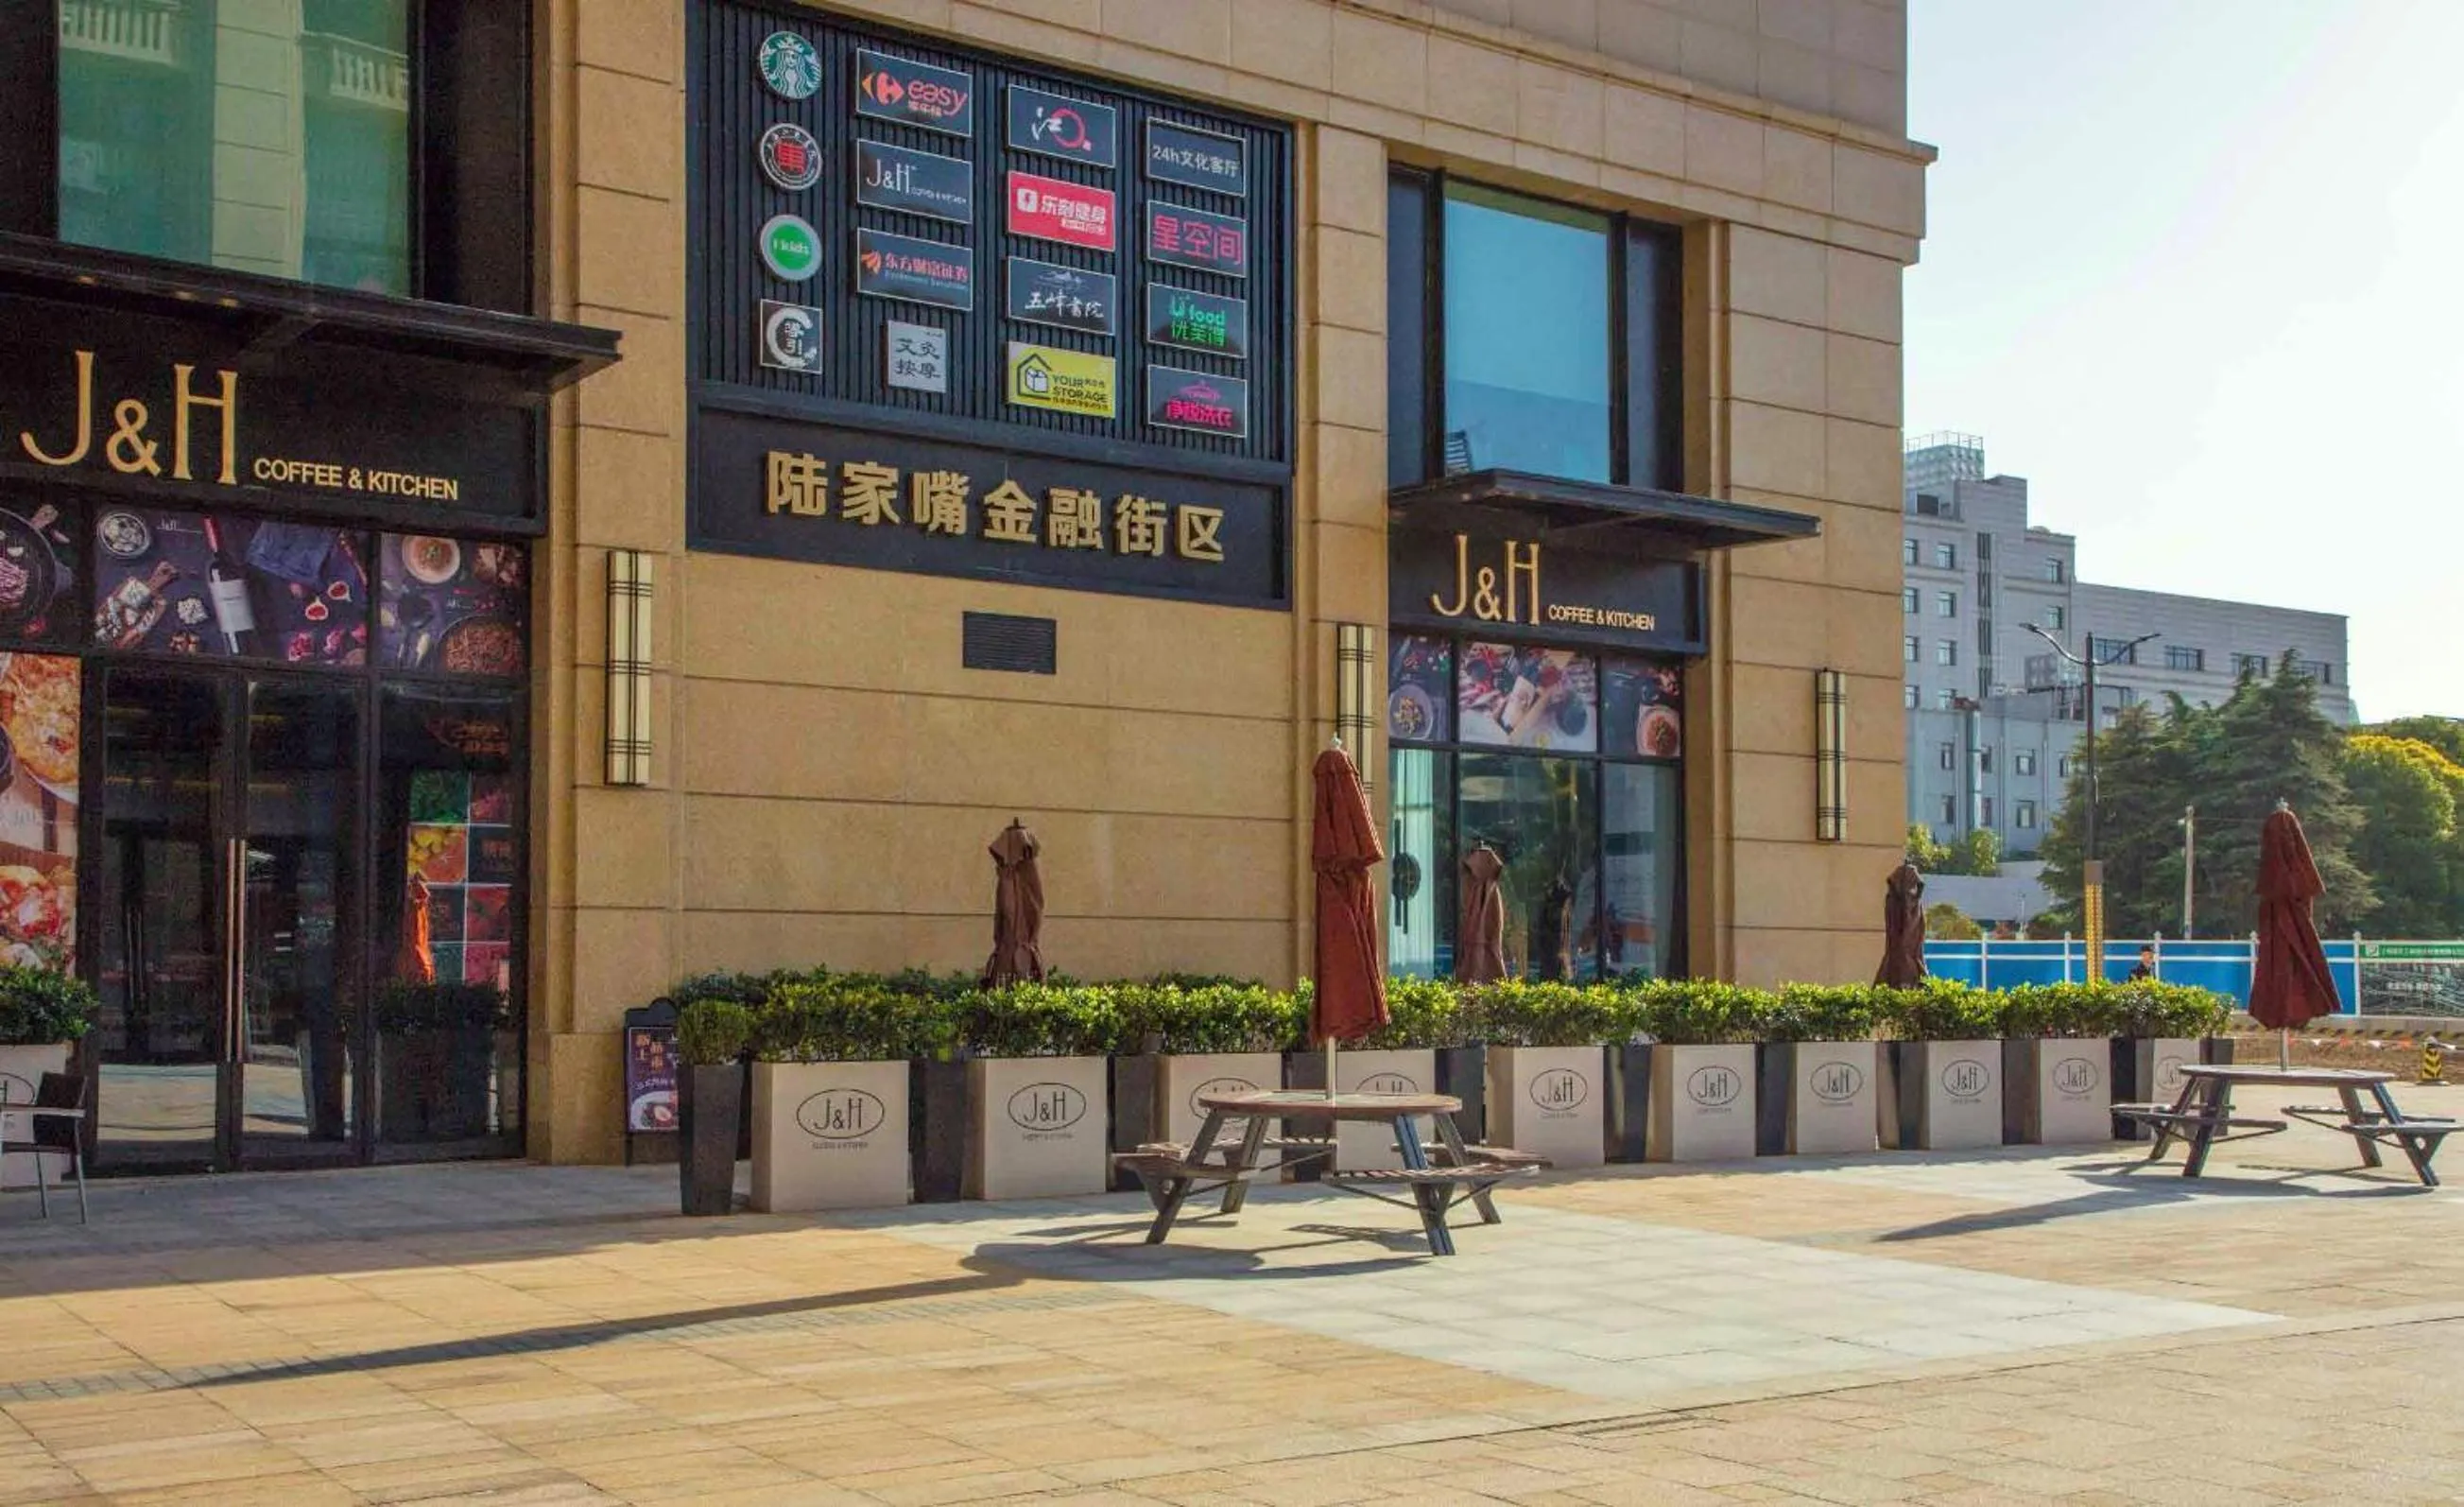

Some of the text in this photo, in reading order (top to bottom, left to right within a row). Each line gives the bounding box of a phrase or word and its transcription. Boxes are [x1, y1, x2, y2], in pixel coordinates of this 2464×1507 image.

[907, 78, 968, 116] easy
[1153, 213, 1242, 265] 星空间
[1052, 374, 1084, 389] YOUR
[1053, 386, 1109, 404] STORAGE
[21, 350, 459, 501] J&H COFFEE & KITCHEN
[767, 449, 1226, 563] 陆家嘴金融街区
[1430, 533, 1656, 632] J&H COFFEE & KITCHEN
[1541, 1076, 1574, 1104] J&H
[1697, 1072, 1728, 1100] J&H
[1821, 1068, 1850, 1094] J&H
[1952, 1065, 1978, 1090] J&H
[813, 1097, 863, 1131] J&H
[1023, 1091, 1066, 1122] J&H
